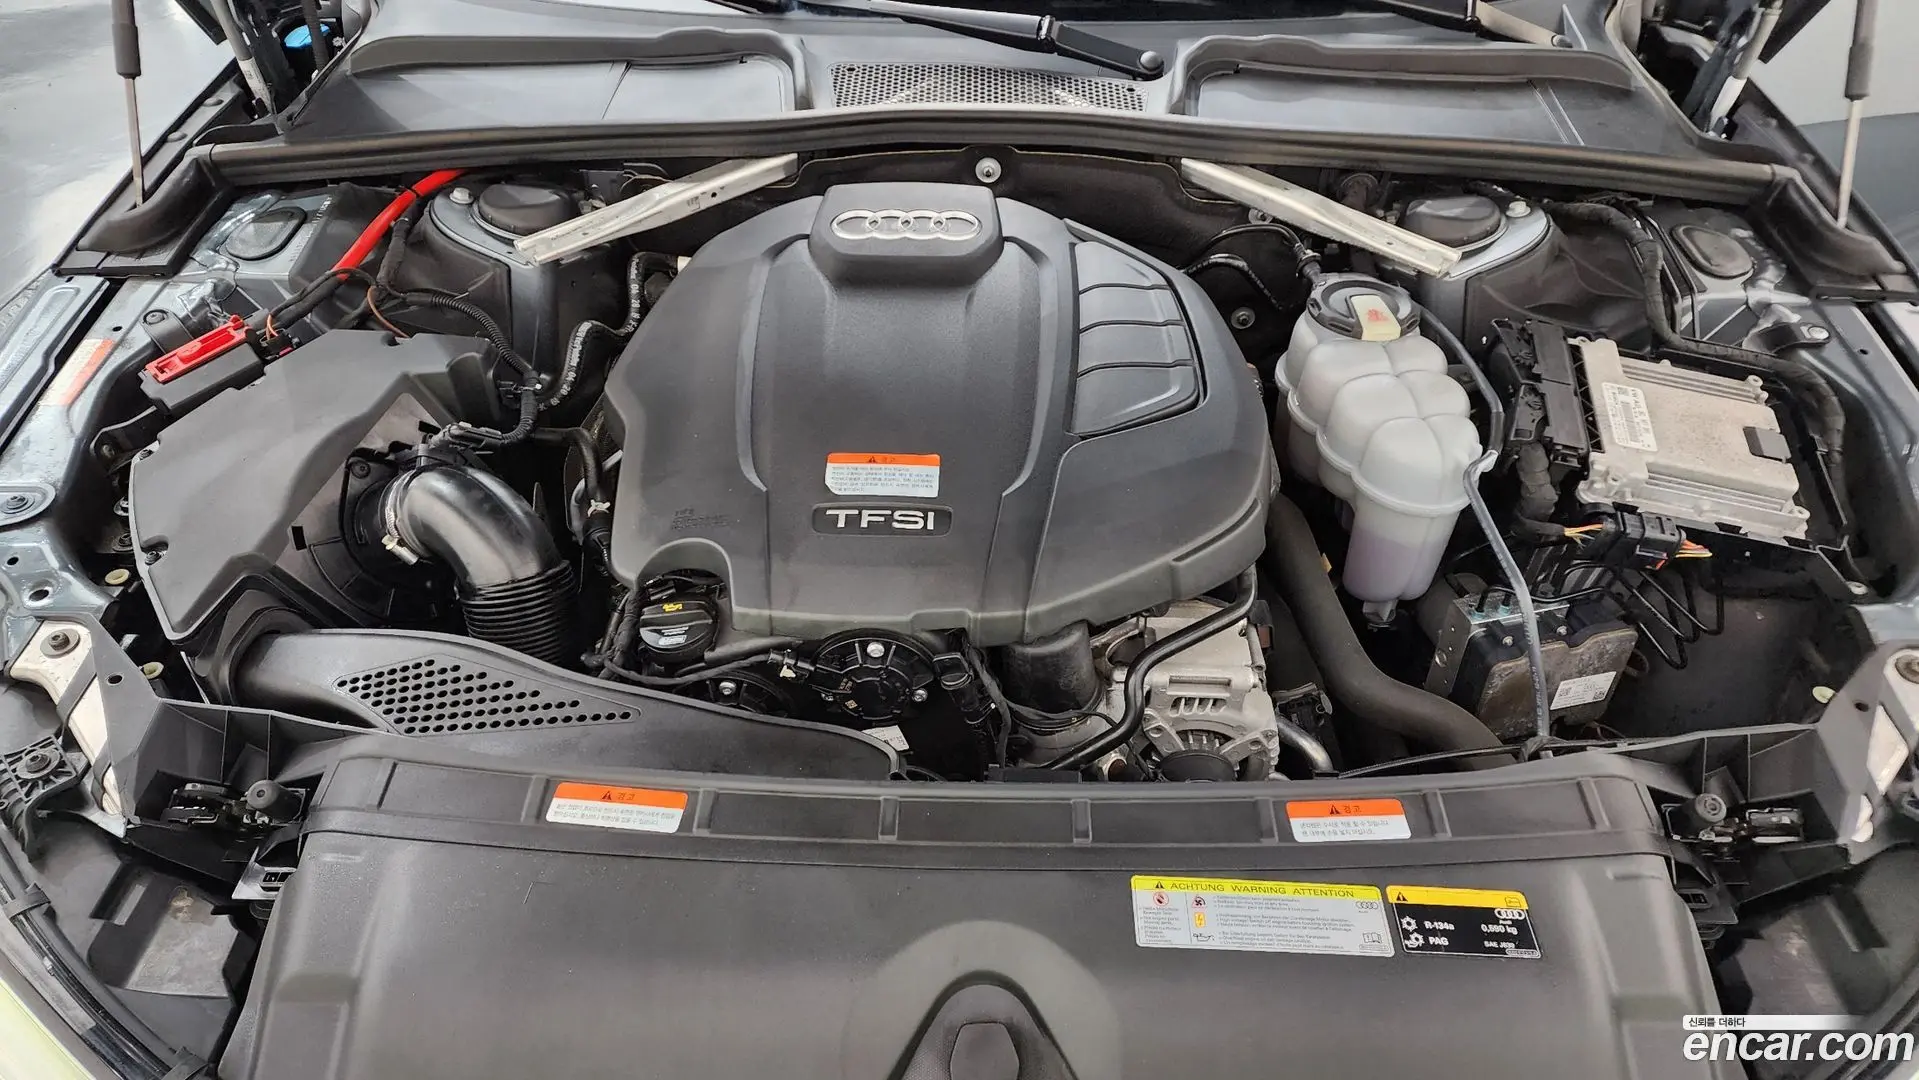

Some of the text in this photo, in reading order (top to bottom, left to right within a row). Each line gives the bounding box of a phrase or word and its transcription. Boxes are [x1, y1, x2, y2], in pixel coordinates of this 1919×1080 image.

[826, 509, 935, 530] TFSI
[1343, 806, 1362, 814] 경고
[1170, 882, 1354, 898] ACHTUNG WARNING ATTENTION
[1424, 921, 1455, 930] R-134a
[1506, 926, 1518, 935] kg
[1428, 936, 1449, 946] PAG
